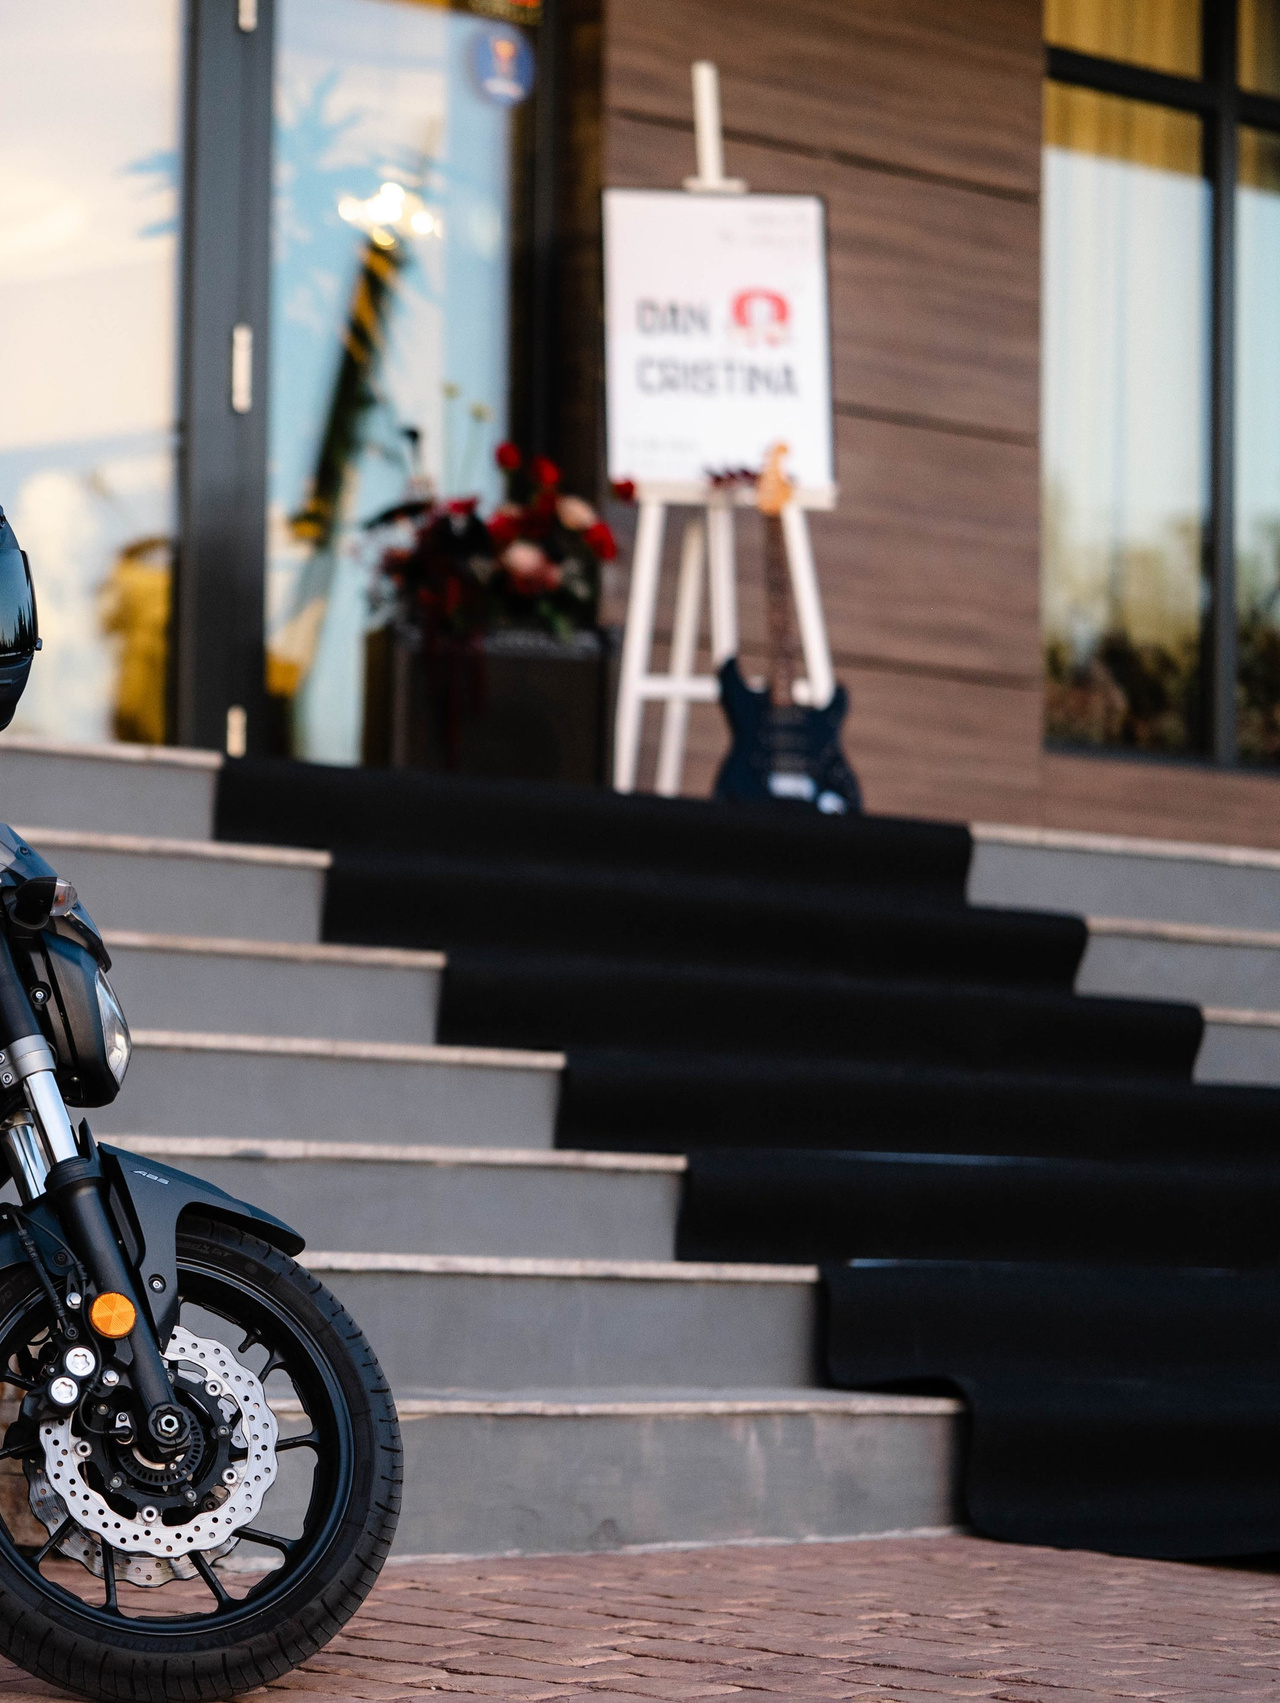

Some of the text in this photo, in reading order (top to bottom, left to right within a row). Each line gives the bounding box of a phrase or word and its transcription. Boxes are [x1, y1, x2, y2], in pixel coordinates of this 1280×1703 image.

[636, 298, 710, 335] DAN
[636, 356, 797, 397] CRISTINA
[133, 1170, 170, 1185] ABS
